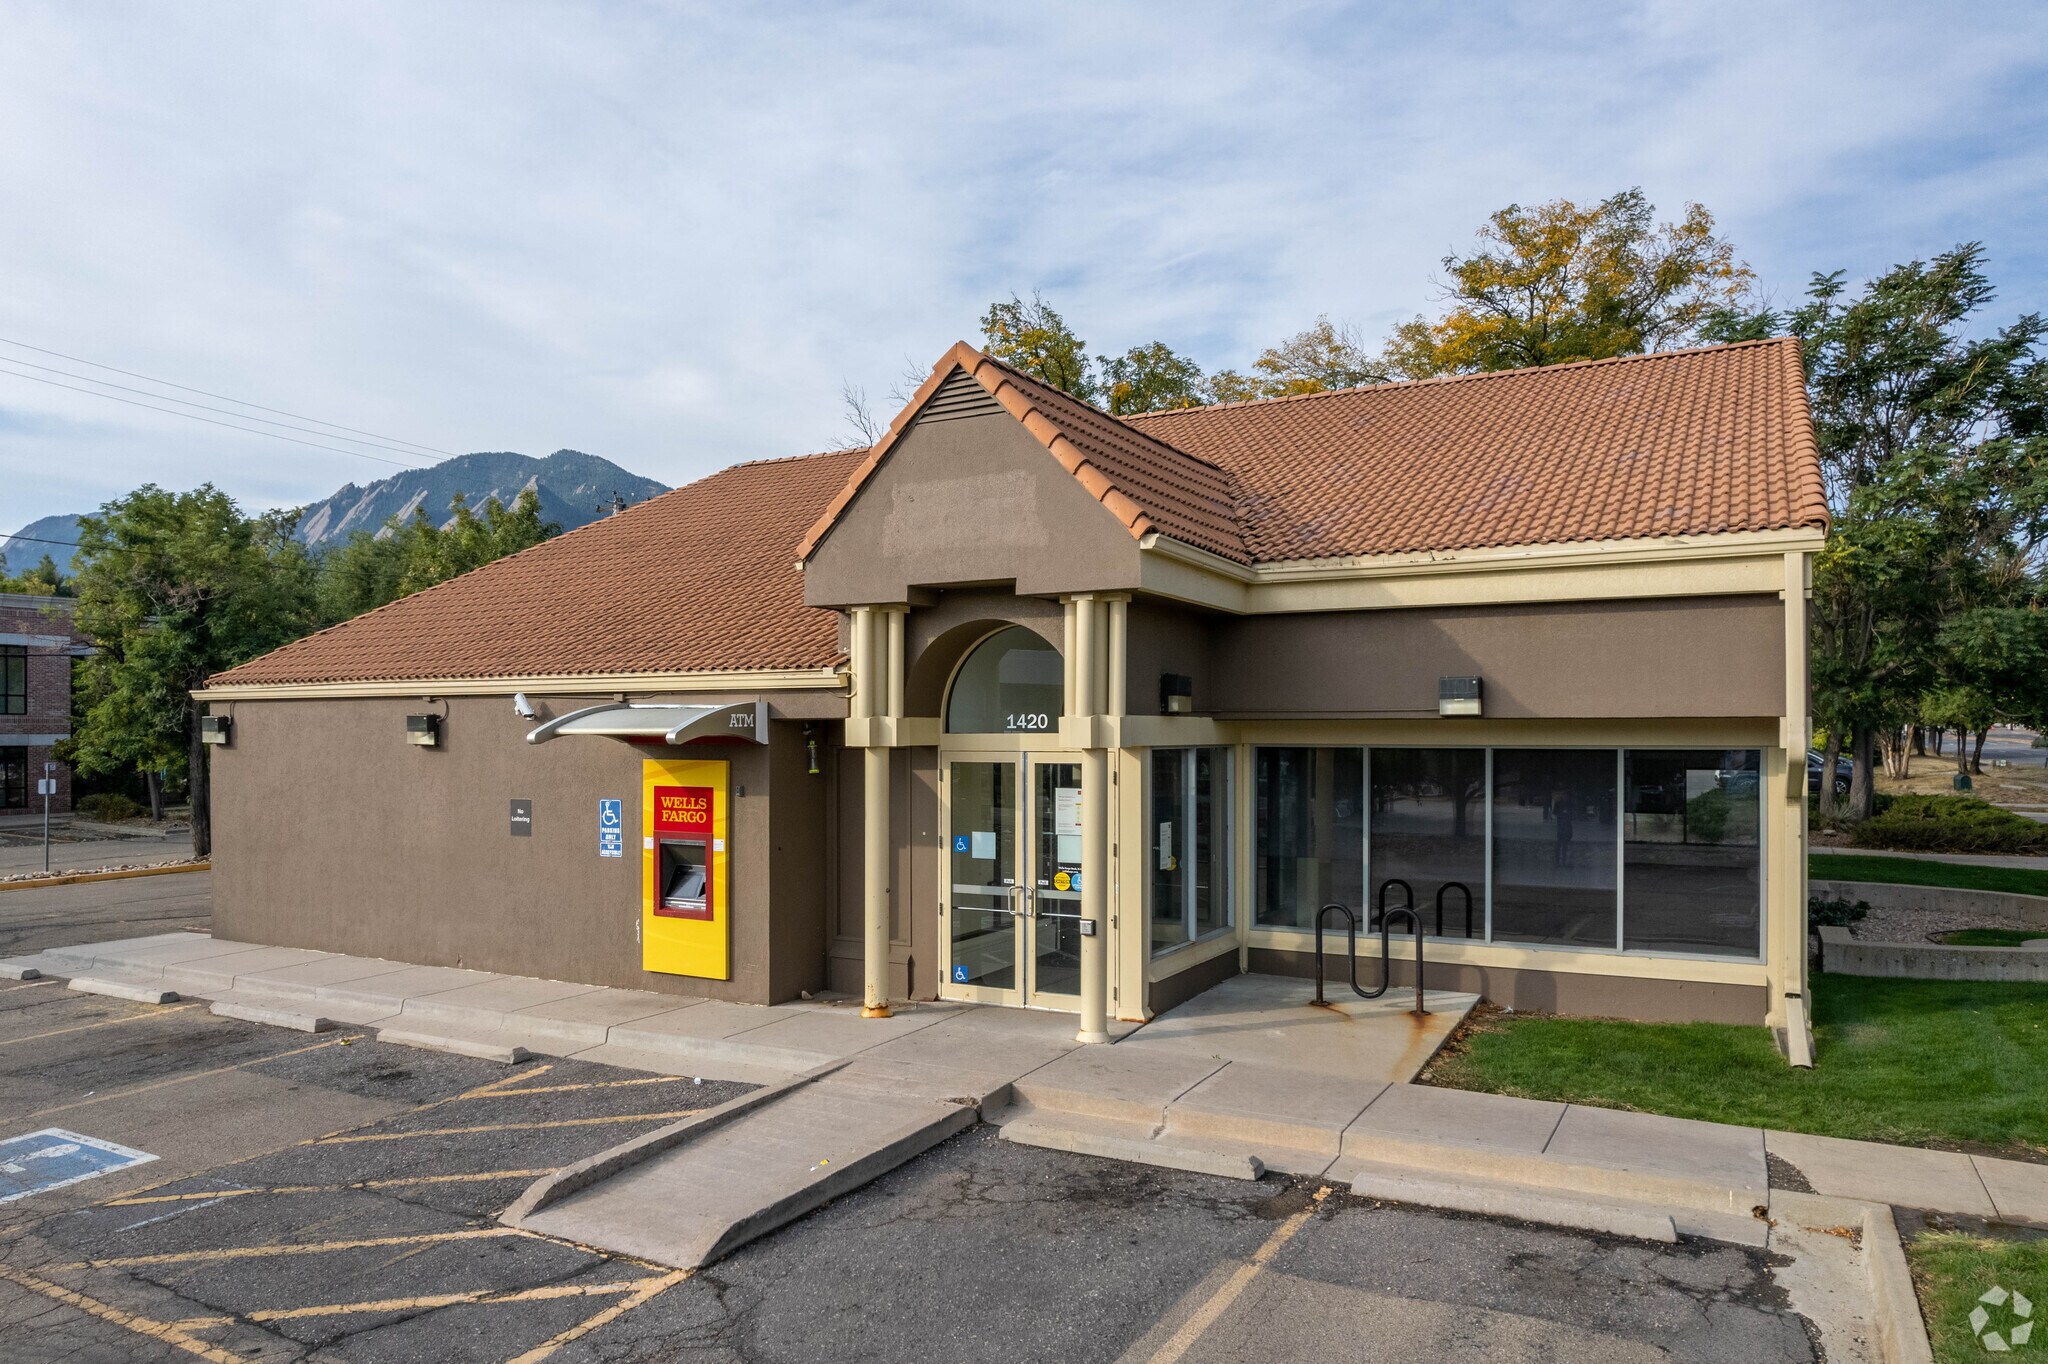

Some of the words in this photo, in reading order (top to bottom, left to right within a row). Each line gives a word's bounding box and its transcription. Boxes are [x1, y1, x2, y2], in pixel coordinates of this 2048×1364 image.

[729, 713, 754, 728] ATM
[1006, 713, 1049, 729] 1420
[660, 796, 707, 810] WELLS
[511, 815, 530, 824] Loitering
[661, 810, 707, 823] FARGO
